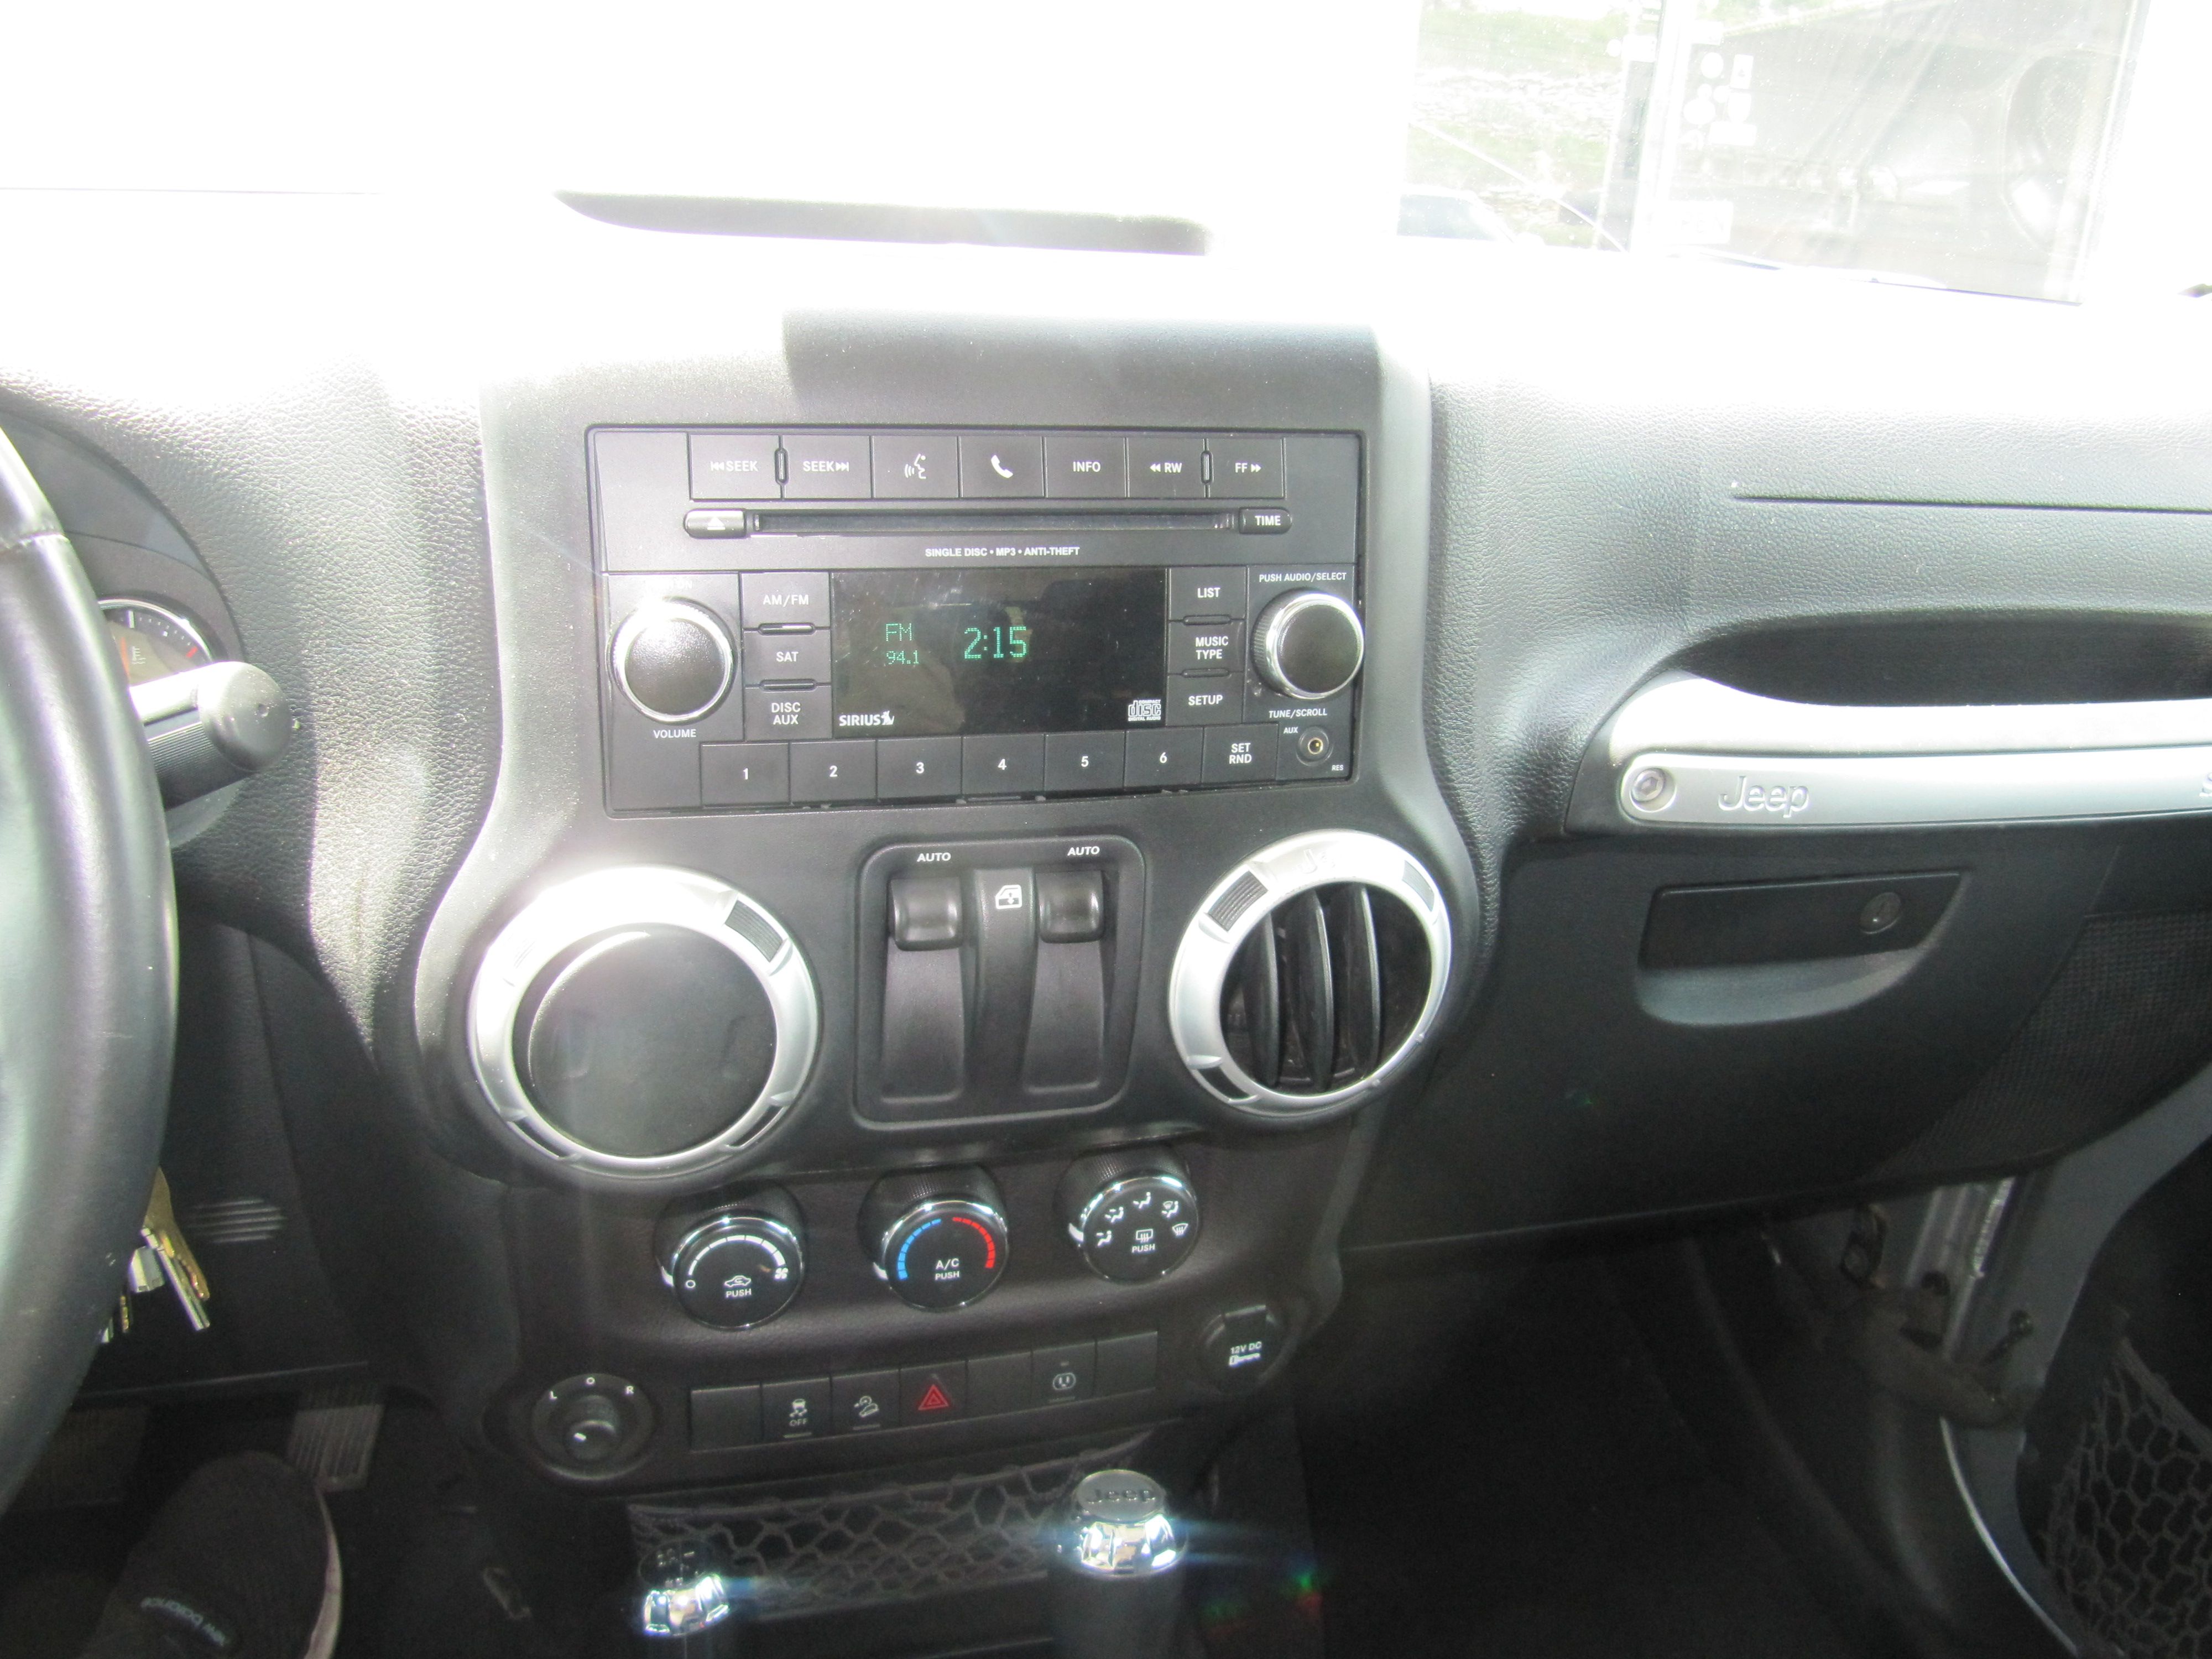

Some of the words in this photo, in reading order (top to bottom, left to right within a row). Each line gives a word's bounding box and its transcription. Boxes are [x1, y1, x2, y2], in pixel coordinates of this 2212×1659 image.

[726, 460, 758, 472] SEEK
[802, 460, 834, 472] SEEK
[1073, 461, 1101, 472] INFO
[1164, 462, 1182, 473] RW
[1235, 462, 1248, 473] FF
[1254, 515, 1281, 526] TIME
[925, 547, 962, 557] SINGLE
[964, 547, 988, 557] DISC
[995, 547, 1016, 556] MP3
[1024, 546, 1080, 556] ANTI-THEFT
[1259, 573, 1282, 583] PUSH
[1284, 572, 1347, 582] AUDIO/SELECT
[1197, 587, 1220, 598] LIST
[763, 594, 809, 606] AM/FM
[885, 623, 912, 641] FM
[964, 626, 1027, 659] 2:15
[1195, 635, 1229, 647] MUSIC
[776, 651, 799, 662] SAT
[886, 650, 919, 665] 94.1
[1196, 649, 1223, 660] TYPE
[1188, 694, 1223, 706] SETUP
[771, 702, 801, 713] DISC
[1269, 708, 1328, 719] TUNE/SCROLL
[773, 714, 799, 725] AUX
[839, 713, 883, 727] SIRIUS
[653, 728, 697, 739] VOLUME
[1231, 742, 1251, 753] SET
[1081, 755, 1089, 768] 5
[1159, 752, 1167, 764] 6
[1229, 753, 1252, 764] RND
[916, 761, 925, 774] 3
[998, 758, 1007, 770] 4
[743, 768, 748, 780] 1
[830, 765, 838, 778] 2
[1717, 775, 1810, 818] Jeep
[1067, 846, 1100, 856] AUTO
[916, 852, 951, 862] AUTO
[1131, 1243, 1156, 1254] PUSH
[935, 1258, 959, 1271] A/C
[935, 1270, 960, 1281] PUSH
[725, 1287, 752, 1298] PUSH
[1230, 1344, 1247, 1354] 12V
[1248, 1341, 1262, 1351] DC
[625, 1385, 634, 1394] R
[550, 1391, 557, 1400] L
[789, 1417, 807, 1427] OFF
[1086, 1486, 1156, 1504] Jeep
